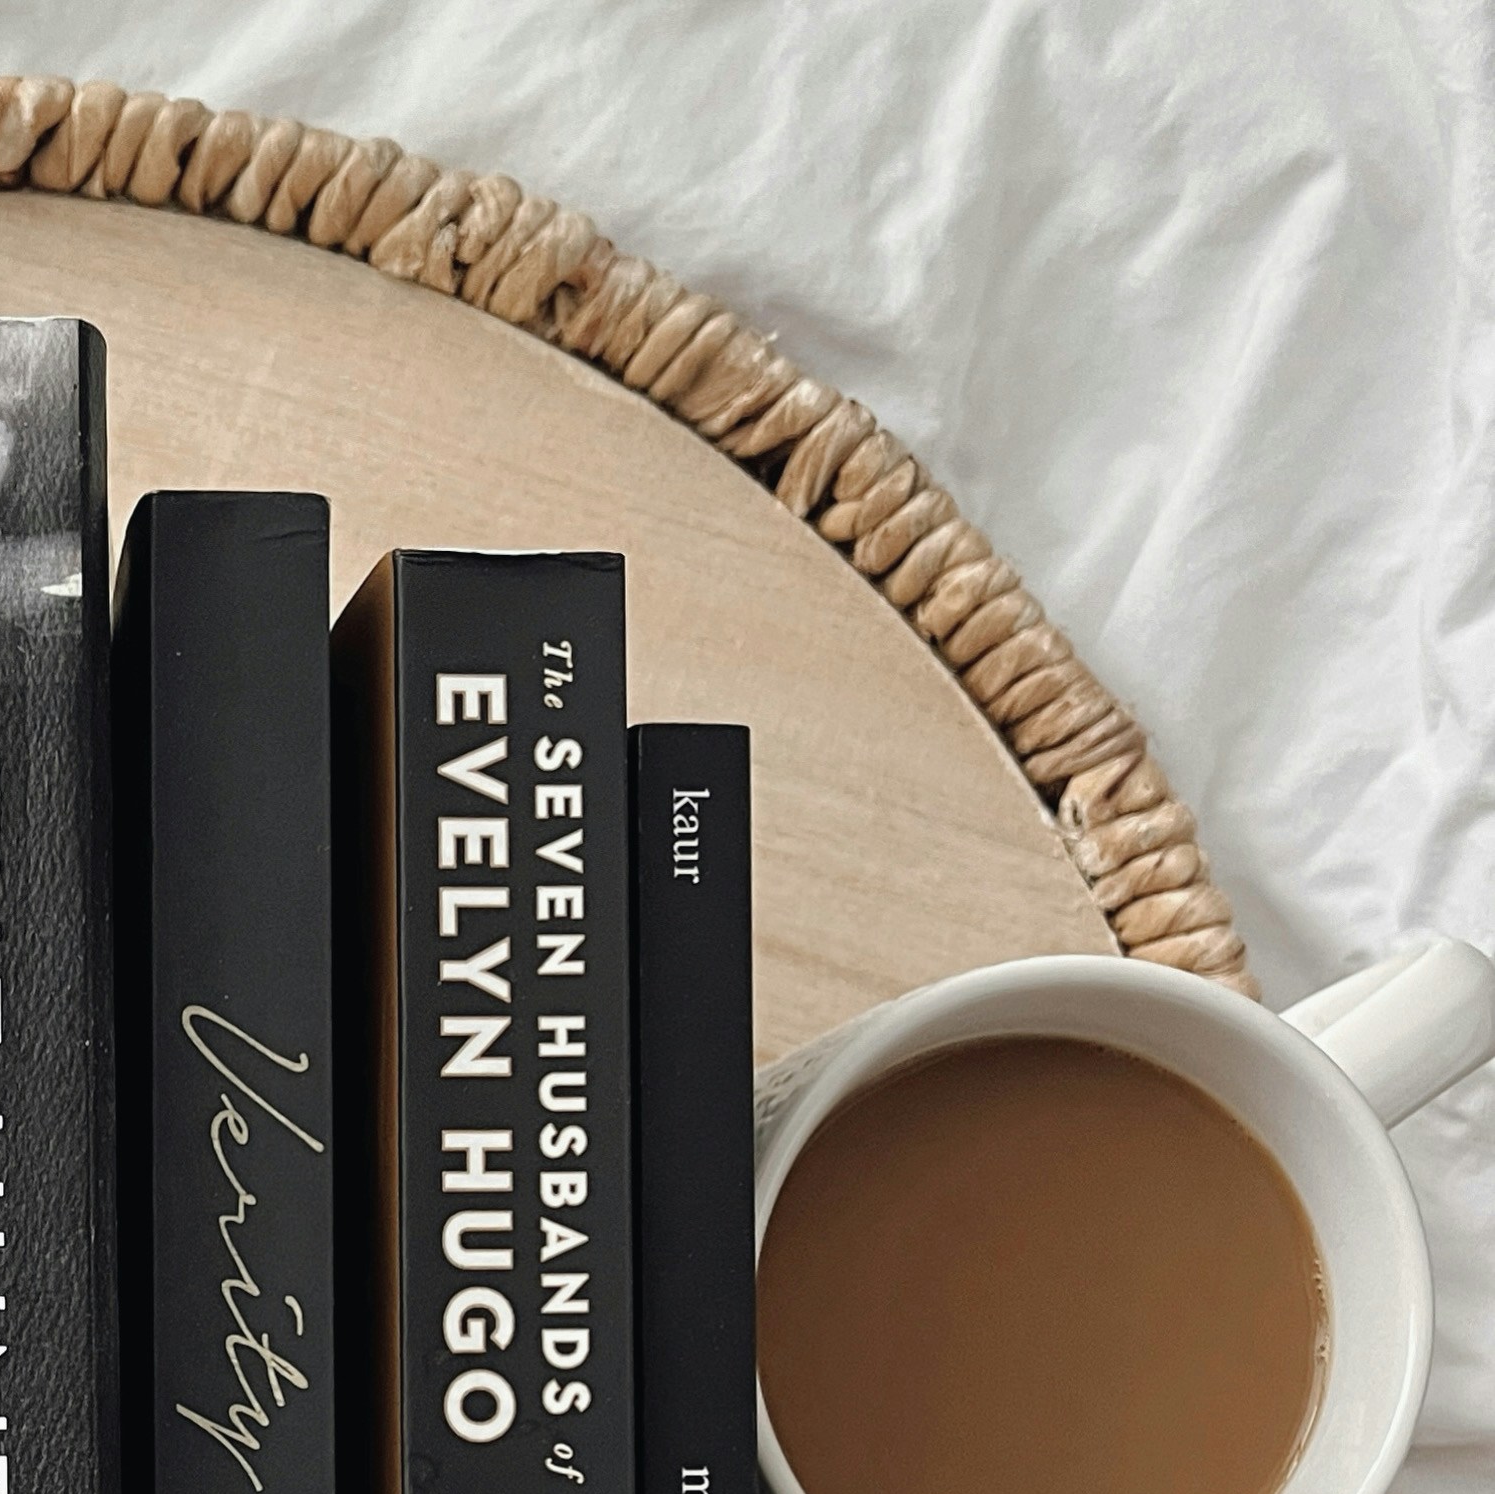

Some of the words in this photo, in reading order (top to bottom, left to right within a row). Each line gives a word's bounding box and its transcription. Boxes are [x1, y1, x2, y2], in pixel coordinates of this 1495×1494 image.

[542, 640, 574, 709] The
[436, 673, 512, 1077] EVELYN
[534, 735, 586, 975] SEVEN
[672, 788, 711, 884] kaur
[176, 1005, 324, 1492] Verity
[441, 1129, 516, 1443] HUGO
[537, 1015, 591, 1415] HUSBANDS
[545, 1443, 585, 1484] of
